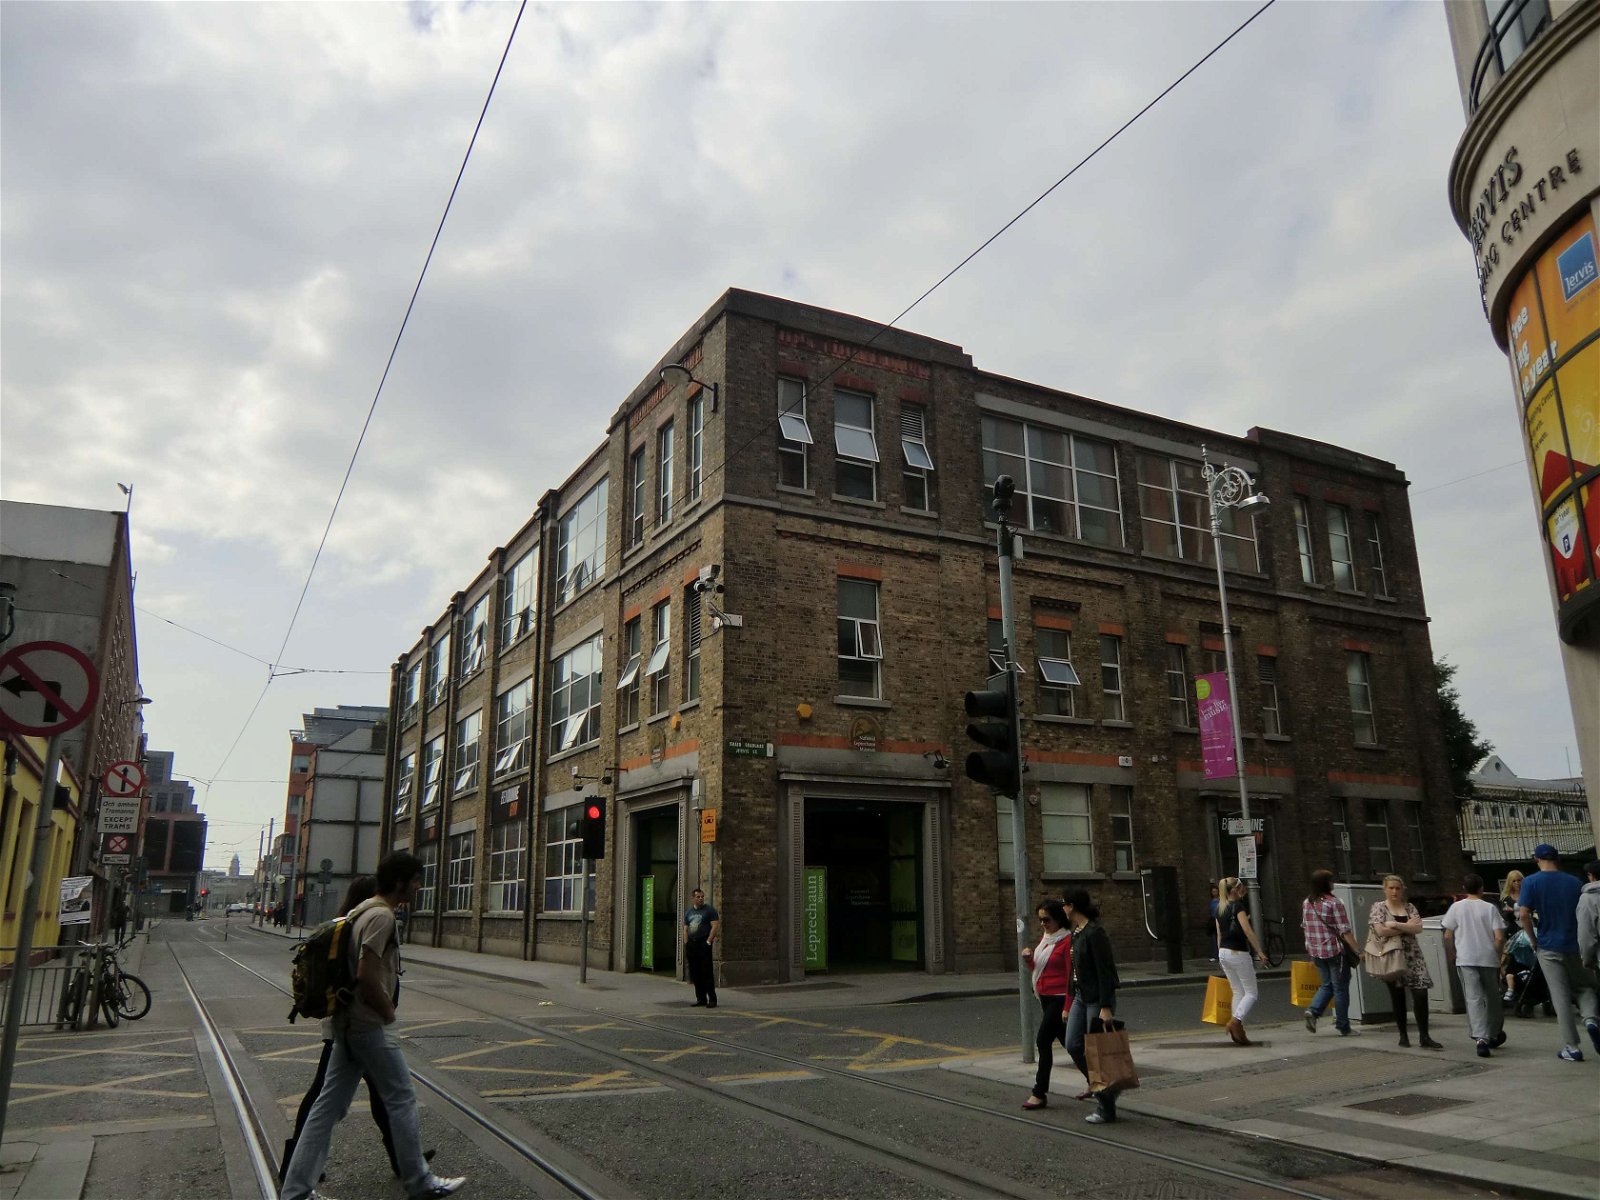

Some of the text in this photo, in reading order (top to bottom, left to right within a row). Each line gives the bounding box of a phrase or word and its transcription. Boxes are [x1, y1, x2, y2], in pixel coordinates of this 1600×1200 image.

[1501, 148, 1582, 245] CENTRE
[1564, 261, 1595, 294] Jervis
[1511, 306, 1529, 340] ree
[805, 875, 820, 961] Leprechaun
